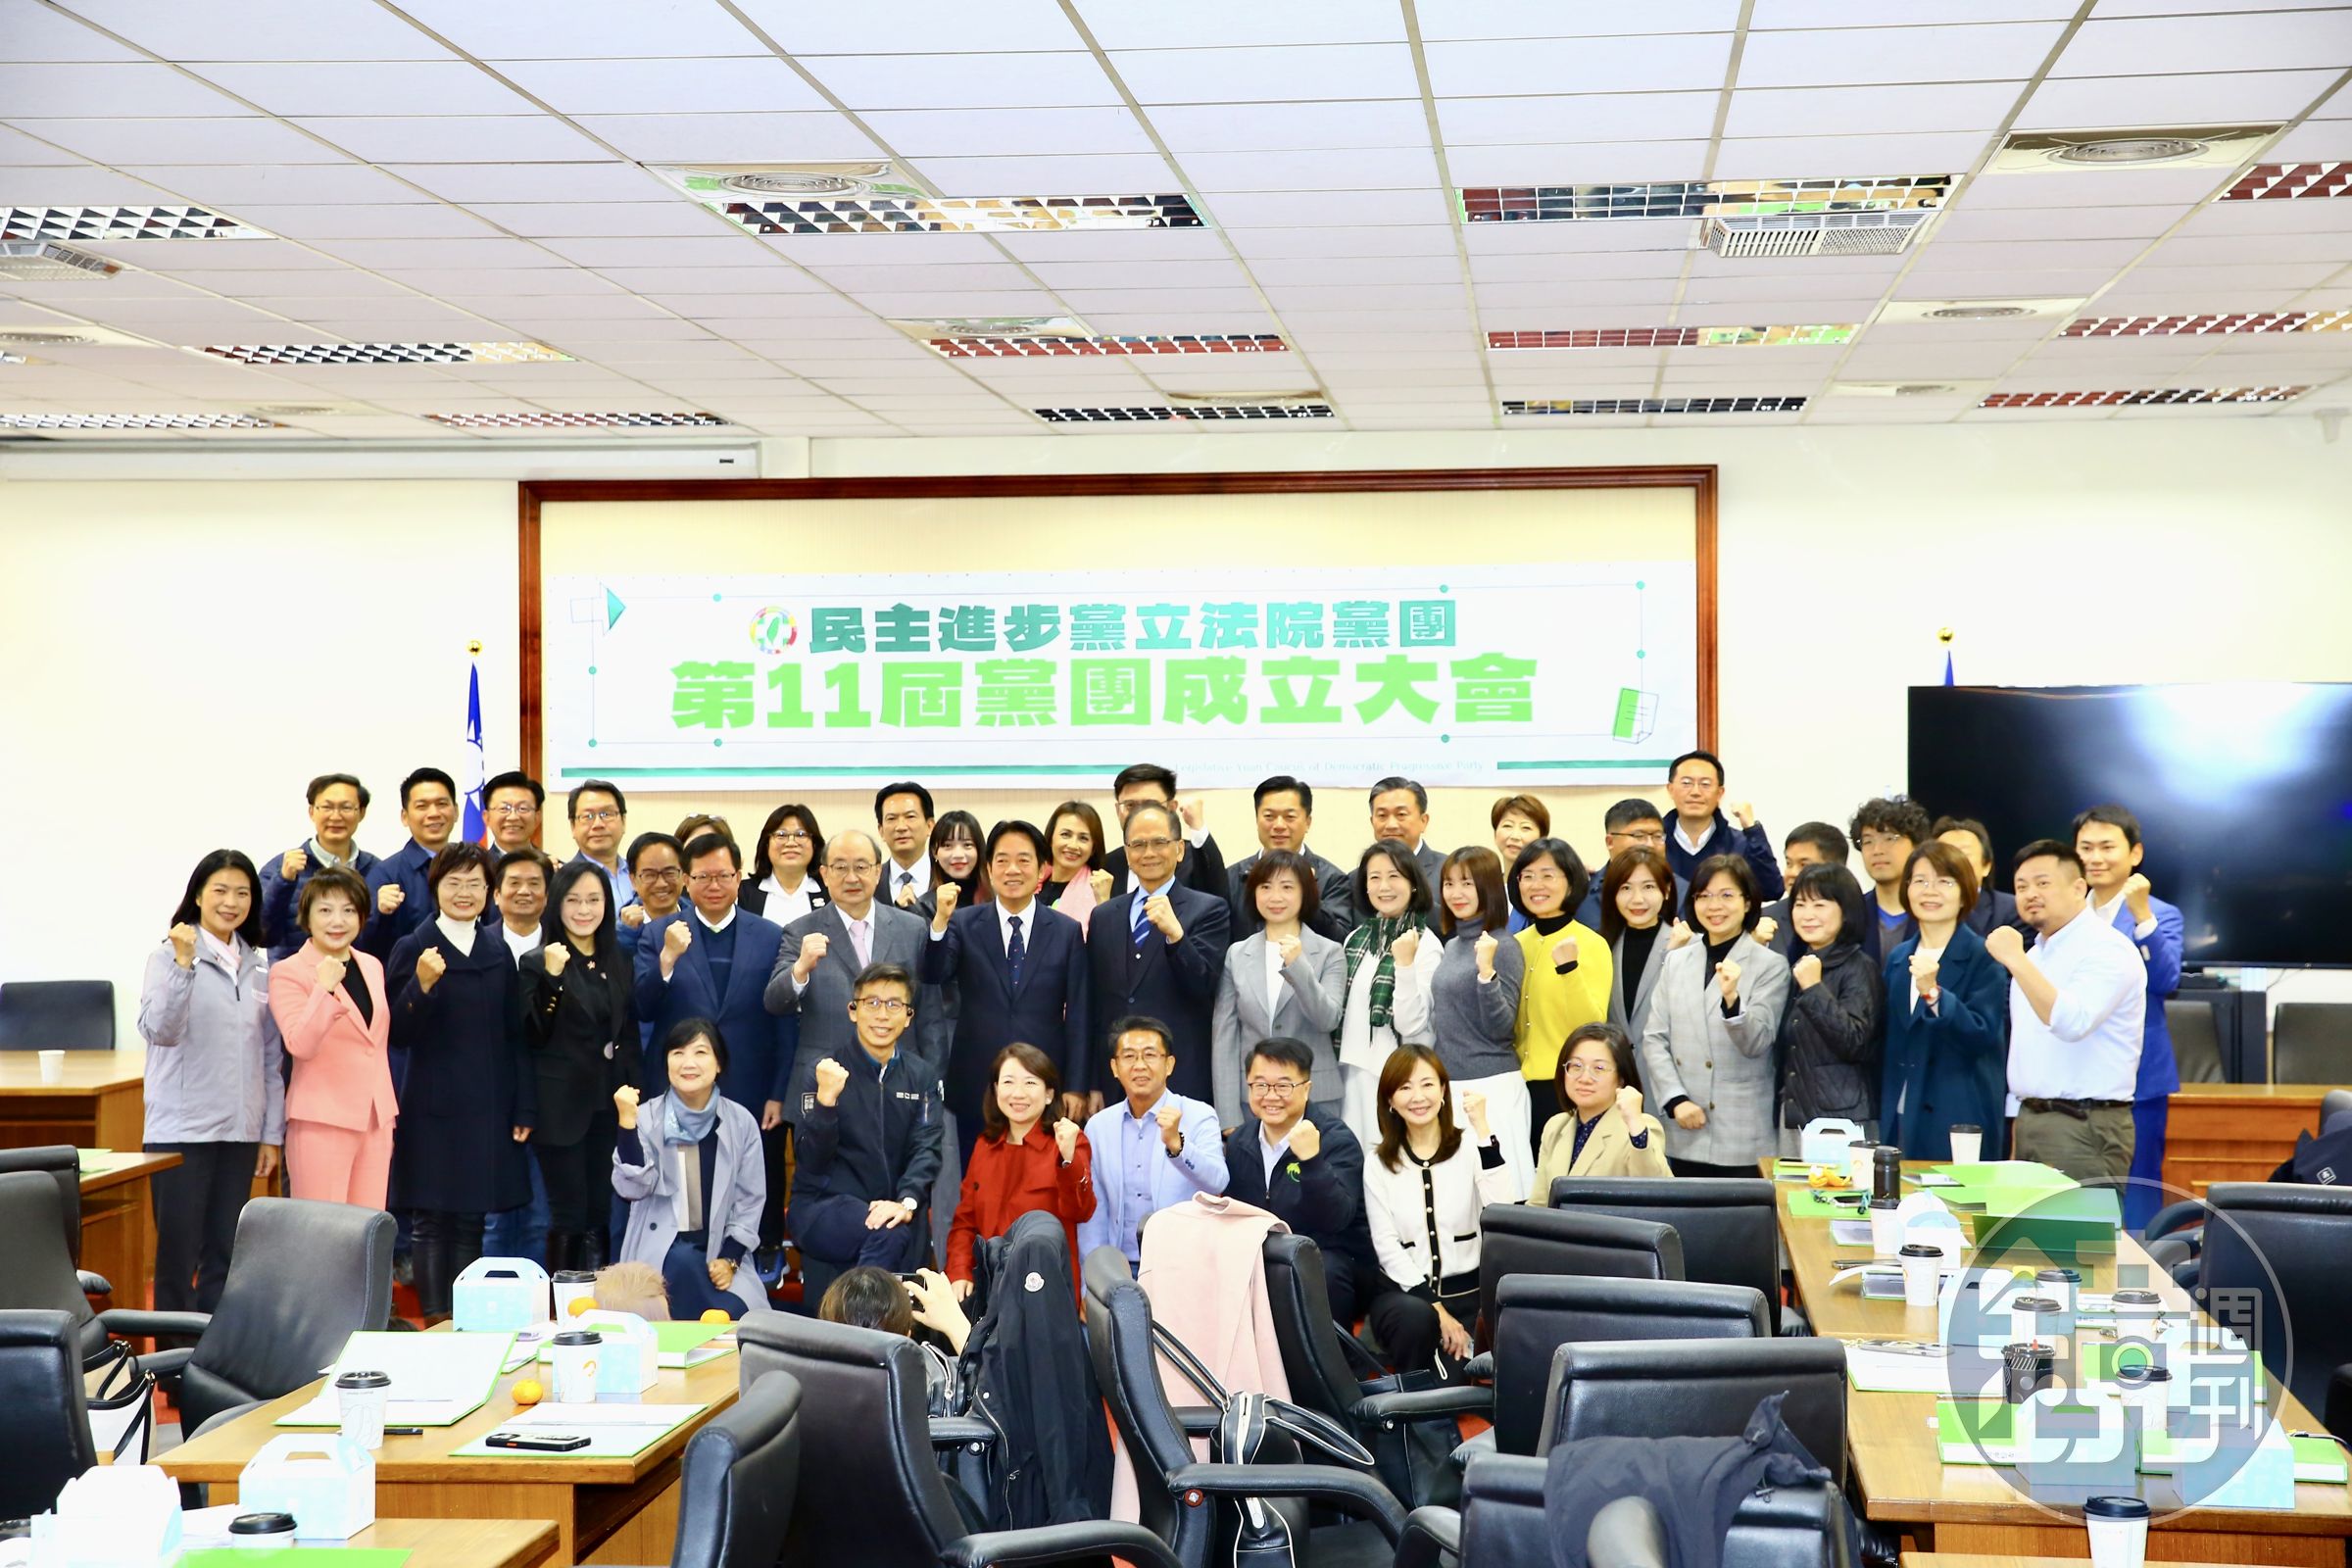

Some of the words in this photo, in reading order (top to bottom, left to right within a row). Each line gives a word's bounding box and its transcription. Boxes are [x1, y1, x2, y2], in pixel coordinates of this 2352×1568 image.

[809, 599, 1456, 654] 民主進步黨立法院黨團
[670, 652, 1538, 729] 第11屆黨團成立大會
